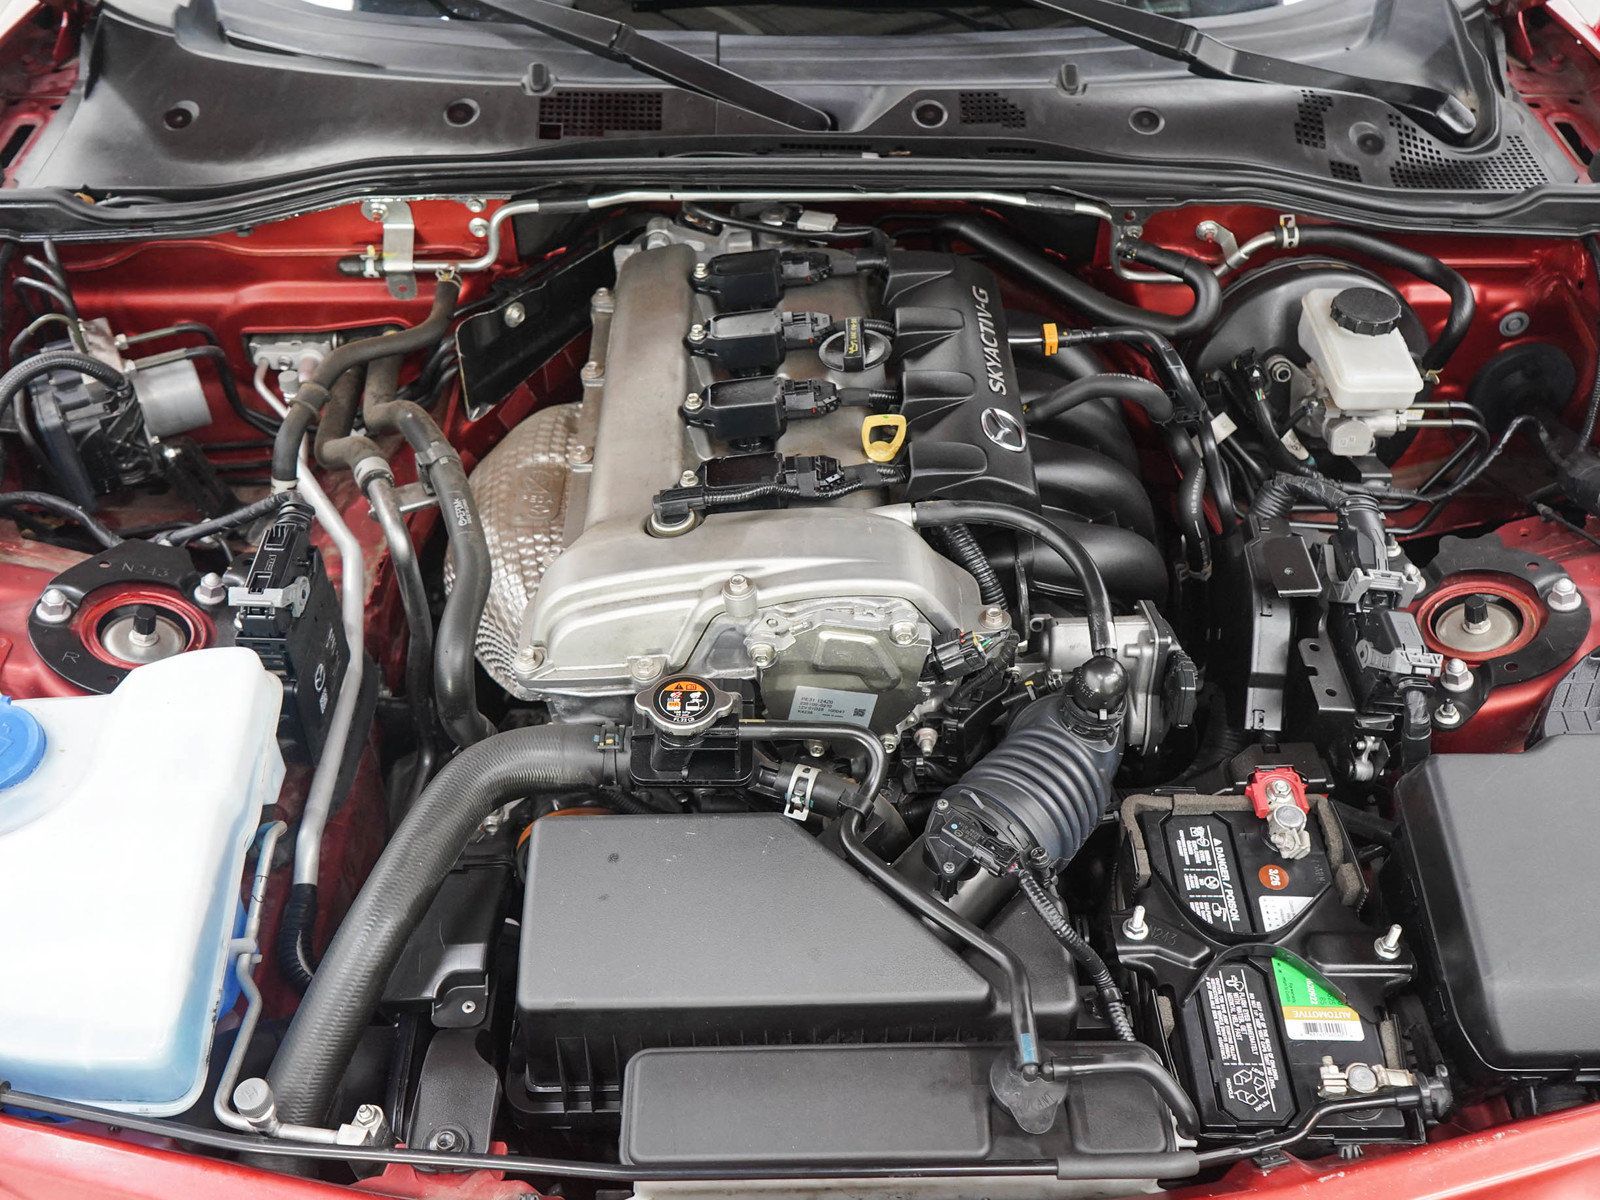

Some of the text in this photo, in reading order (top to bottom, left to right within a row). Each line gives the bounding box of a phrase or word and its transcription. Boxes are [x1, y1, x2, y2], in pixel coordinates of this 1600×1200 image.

[972, 285, 1007, 396] SKYACTIV-G
[1214, 846, 1230, 880] DANGER
[1224, 889, 1240, 920] POISON
[1268, 868, 1282, 887] 3/26
[1231, 1014, 1239, 1027] HELP
[1238, 992, 1259, 1055] FLUSH EYES IMMEDIATELY
[1293, 1010, 1350, 1018] AUTOMOTIVE
[1234, 1028, 1243, 1041] FAST
[1224, 1078, 1234, 1098] RECYCLE
